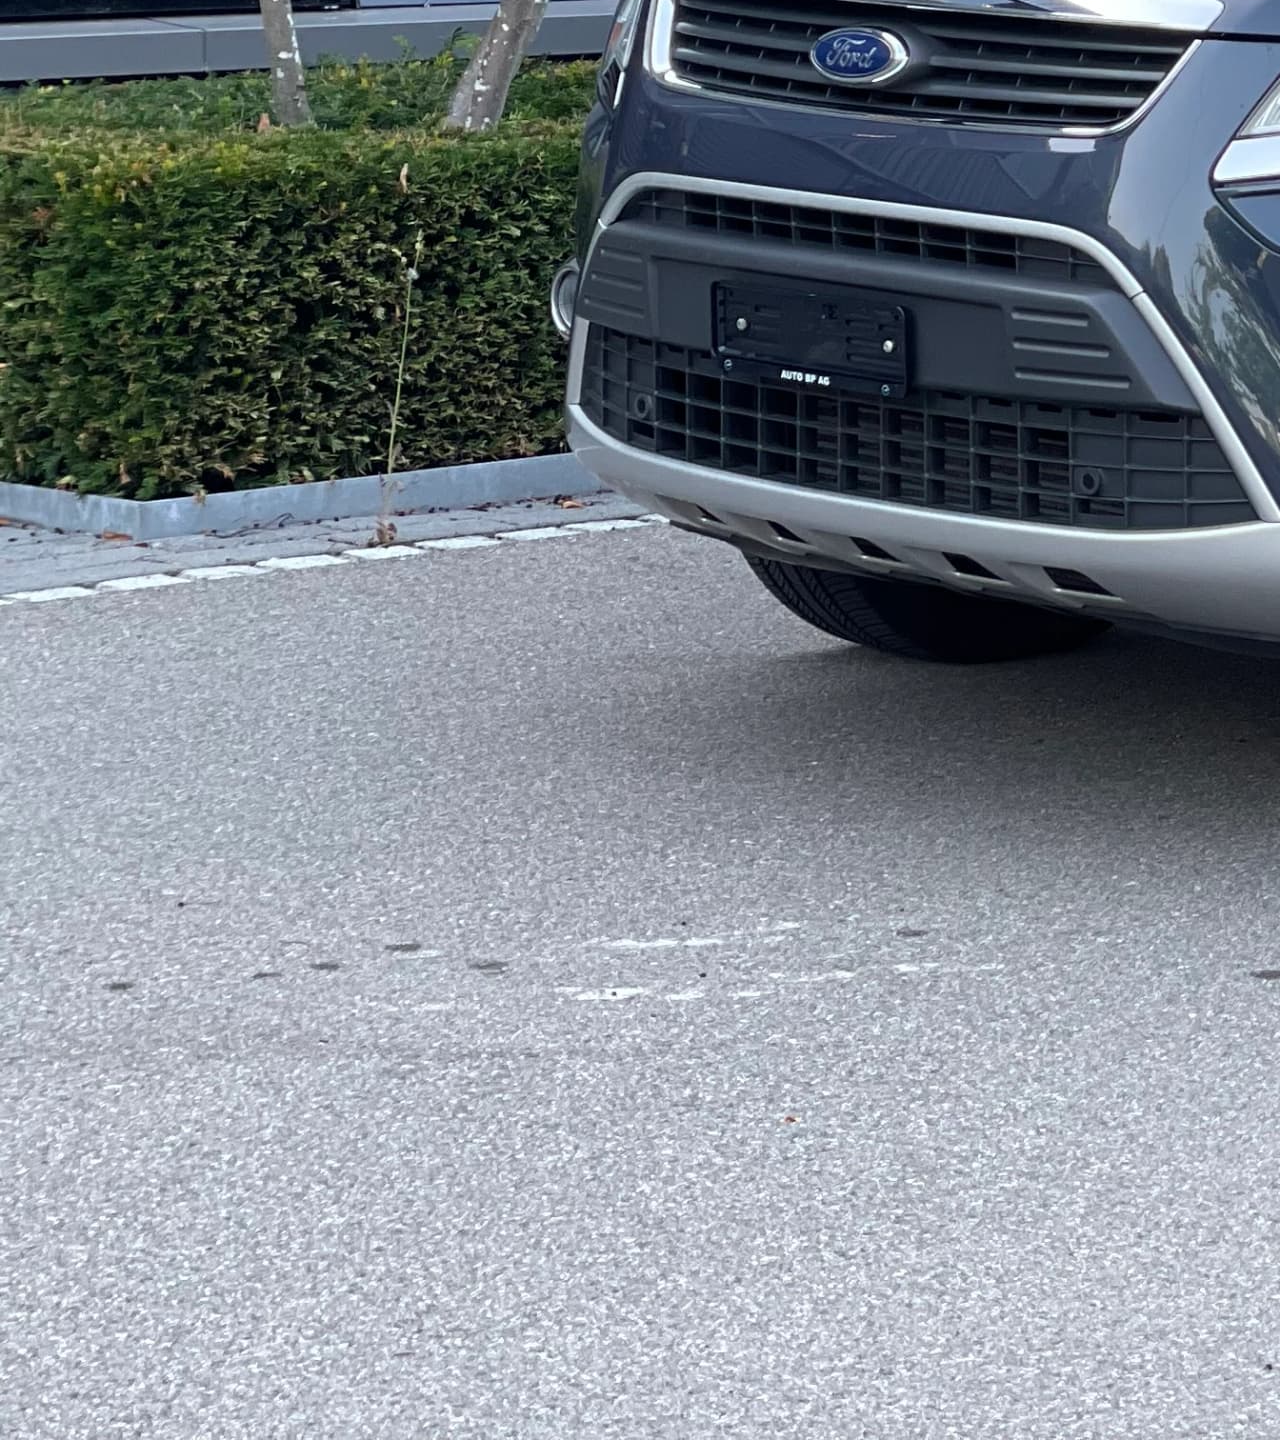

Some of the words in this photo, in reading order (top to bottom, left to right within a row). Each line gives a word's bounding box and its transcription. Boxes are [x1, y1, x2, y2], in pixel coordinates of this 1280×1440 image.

[826, 37, 877, 68] Ford
[781, 369, 803, 381] AUTO
[817, 375, 830, 386] AG
